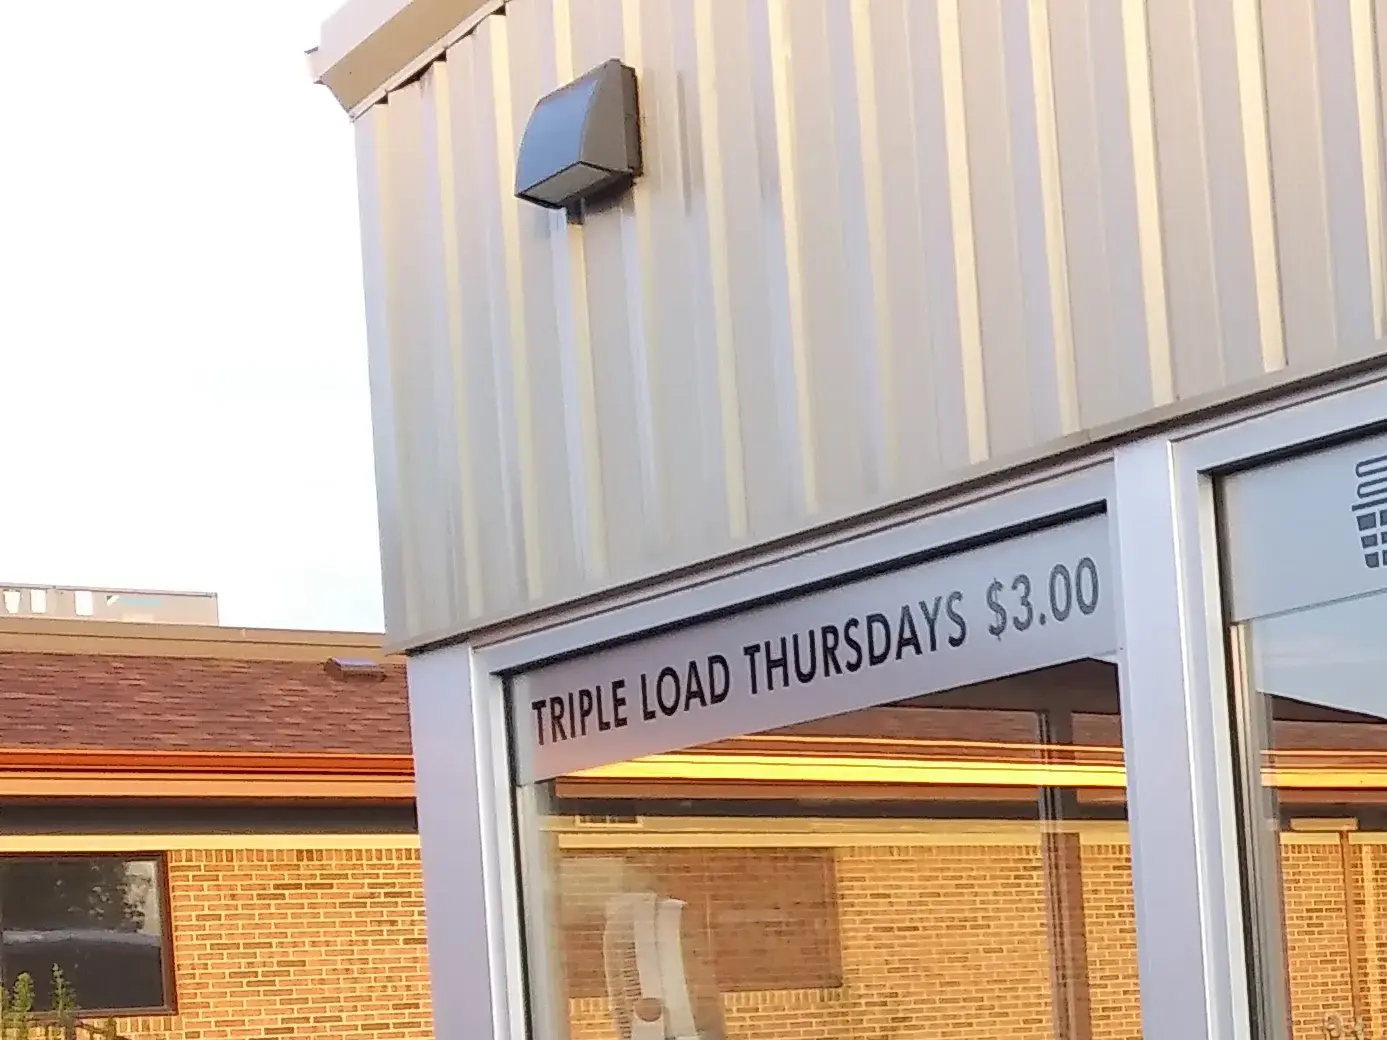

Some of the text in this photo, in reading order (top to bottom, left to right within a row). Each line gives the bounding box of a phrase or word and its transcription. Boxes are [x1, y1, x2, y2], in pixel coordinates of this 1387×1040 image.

[532, 556, 1101, 746] TRIPLE LOAD THURSDAYS $3.00
